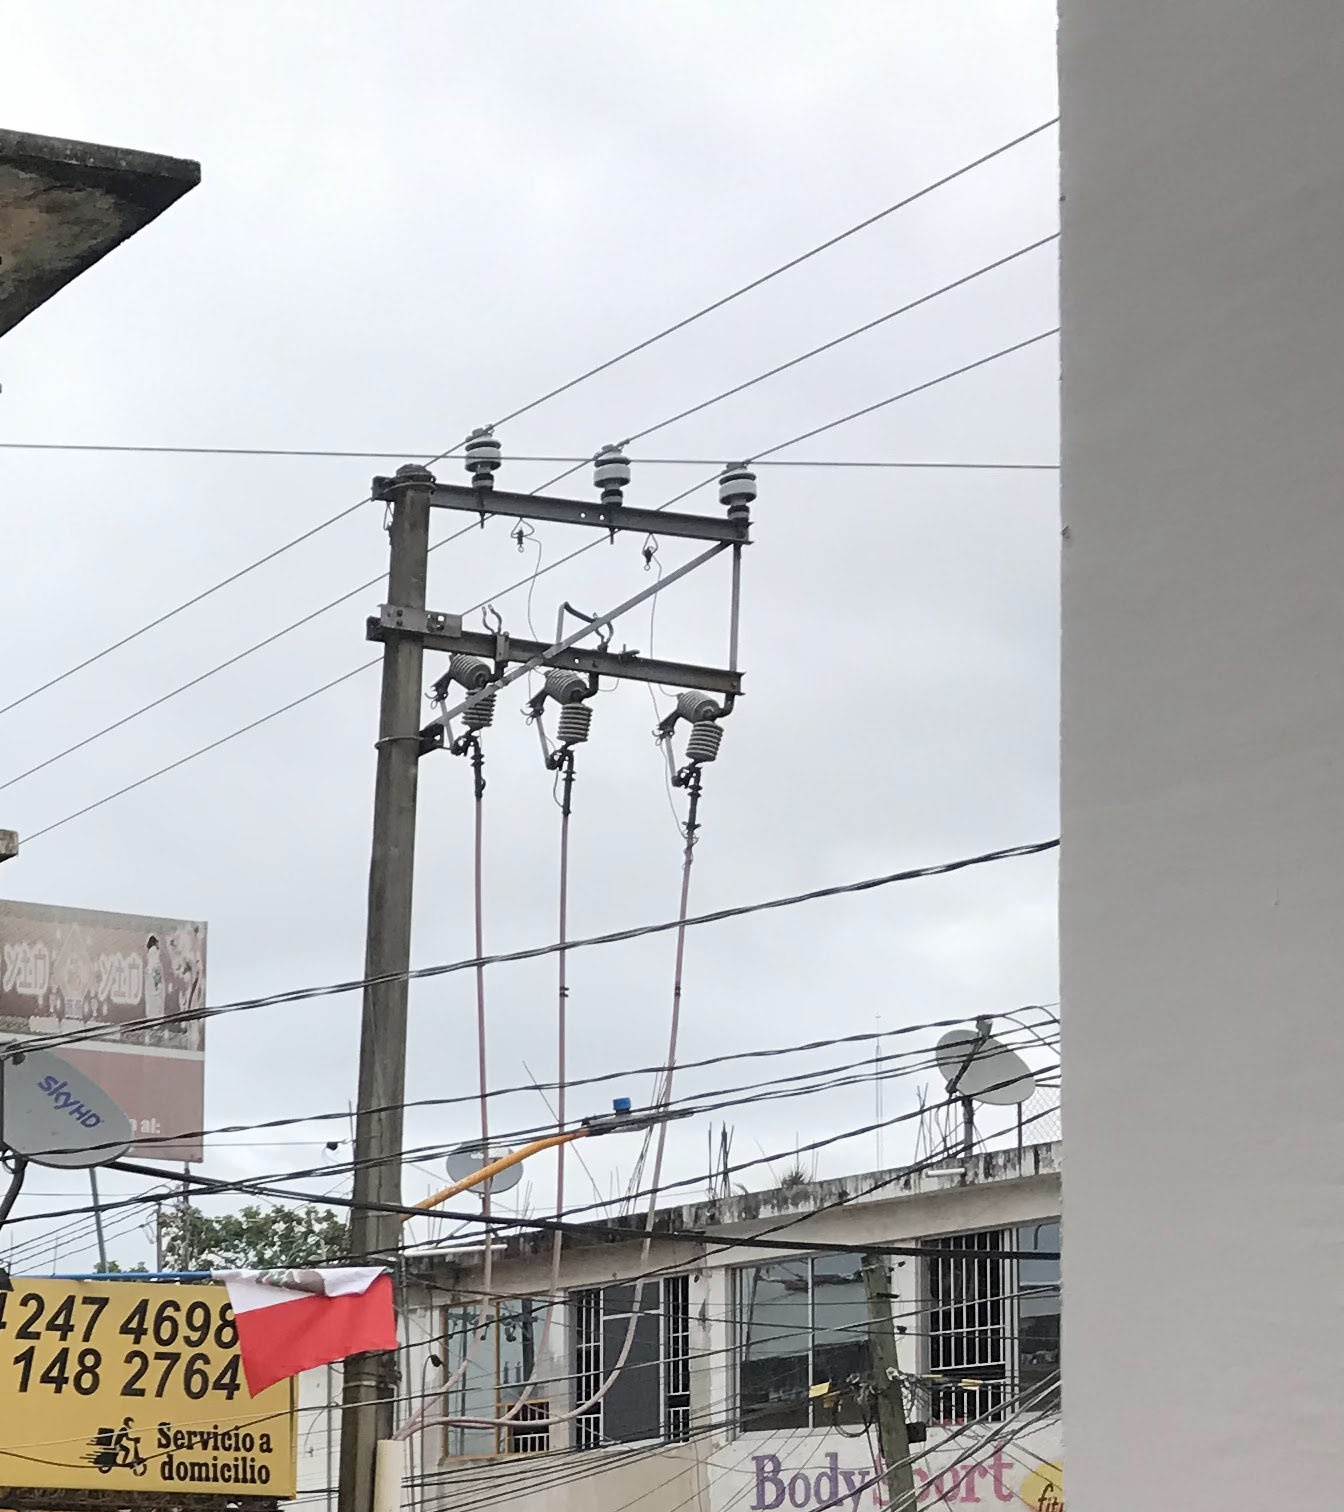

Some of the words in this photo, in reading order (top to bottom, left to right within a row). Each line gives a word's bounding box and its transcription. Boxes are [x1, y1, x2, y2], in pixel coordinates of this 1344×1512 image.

[15, 1292, 110, 1343] 247
[119, 1298, 239, 1350] 4698
[12, 1346, 101, 1396] 148
[119, 1350, 241, 1400] 2764
[156, 1421, 255, 1454] Servicio
[258, 1438, 273, 1454] a
[160, 1456, 271, 1485] domicilio
